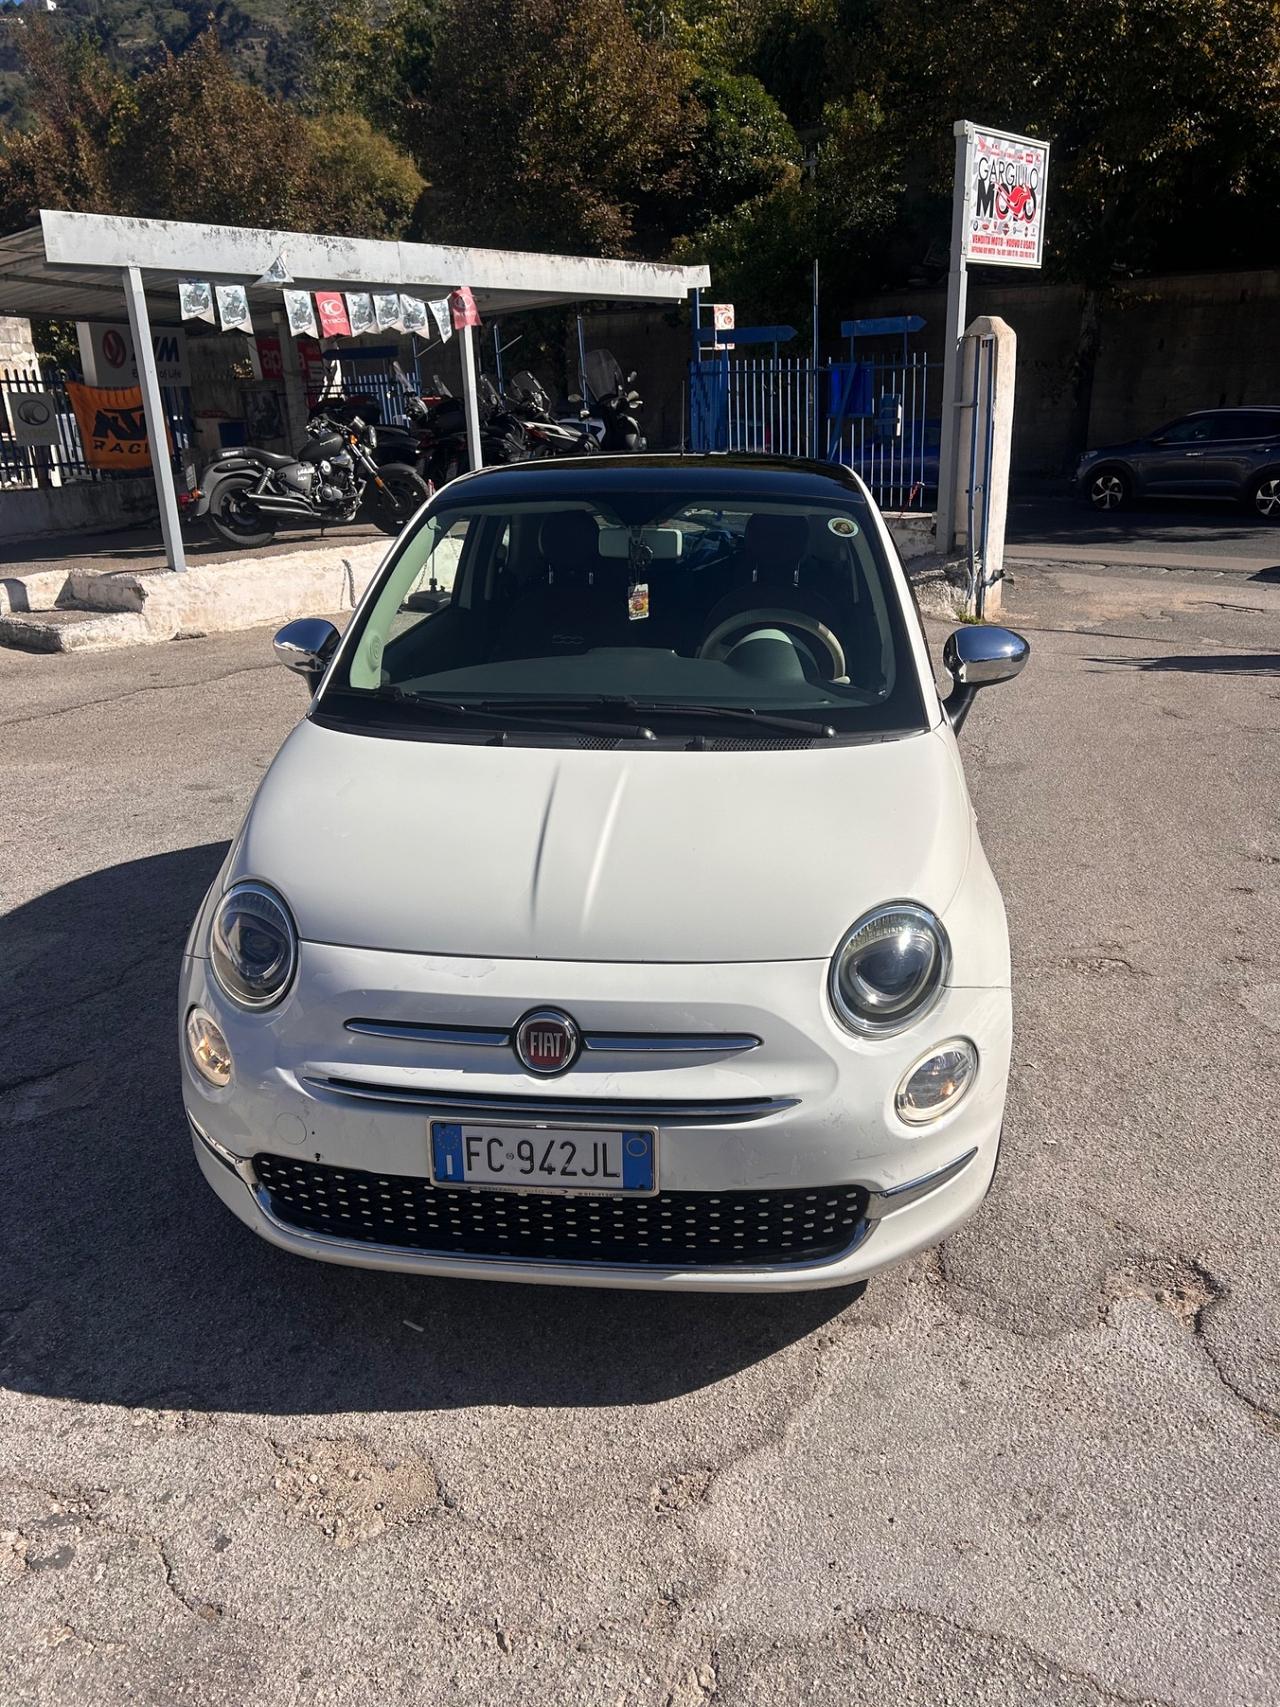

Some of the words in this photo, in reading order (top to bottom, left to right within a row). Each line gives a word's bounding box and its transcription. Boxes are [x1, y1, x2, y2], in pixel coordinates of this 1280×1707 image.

[92, 404, 149, 441] KT
[530, 1031, 563, 1058] FIAT
[465, 1136, 505, 1173] FC
[516, 1139, 621, 1178] 942JL
